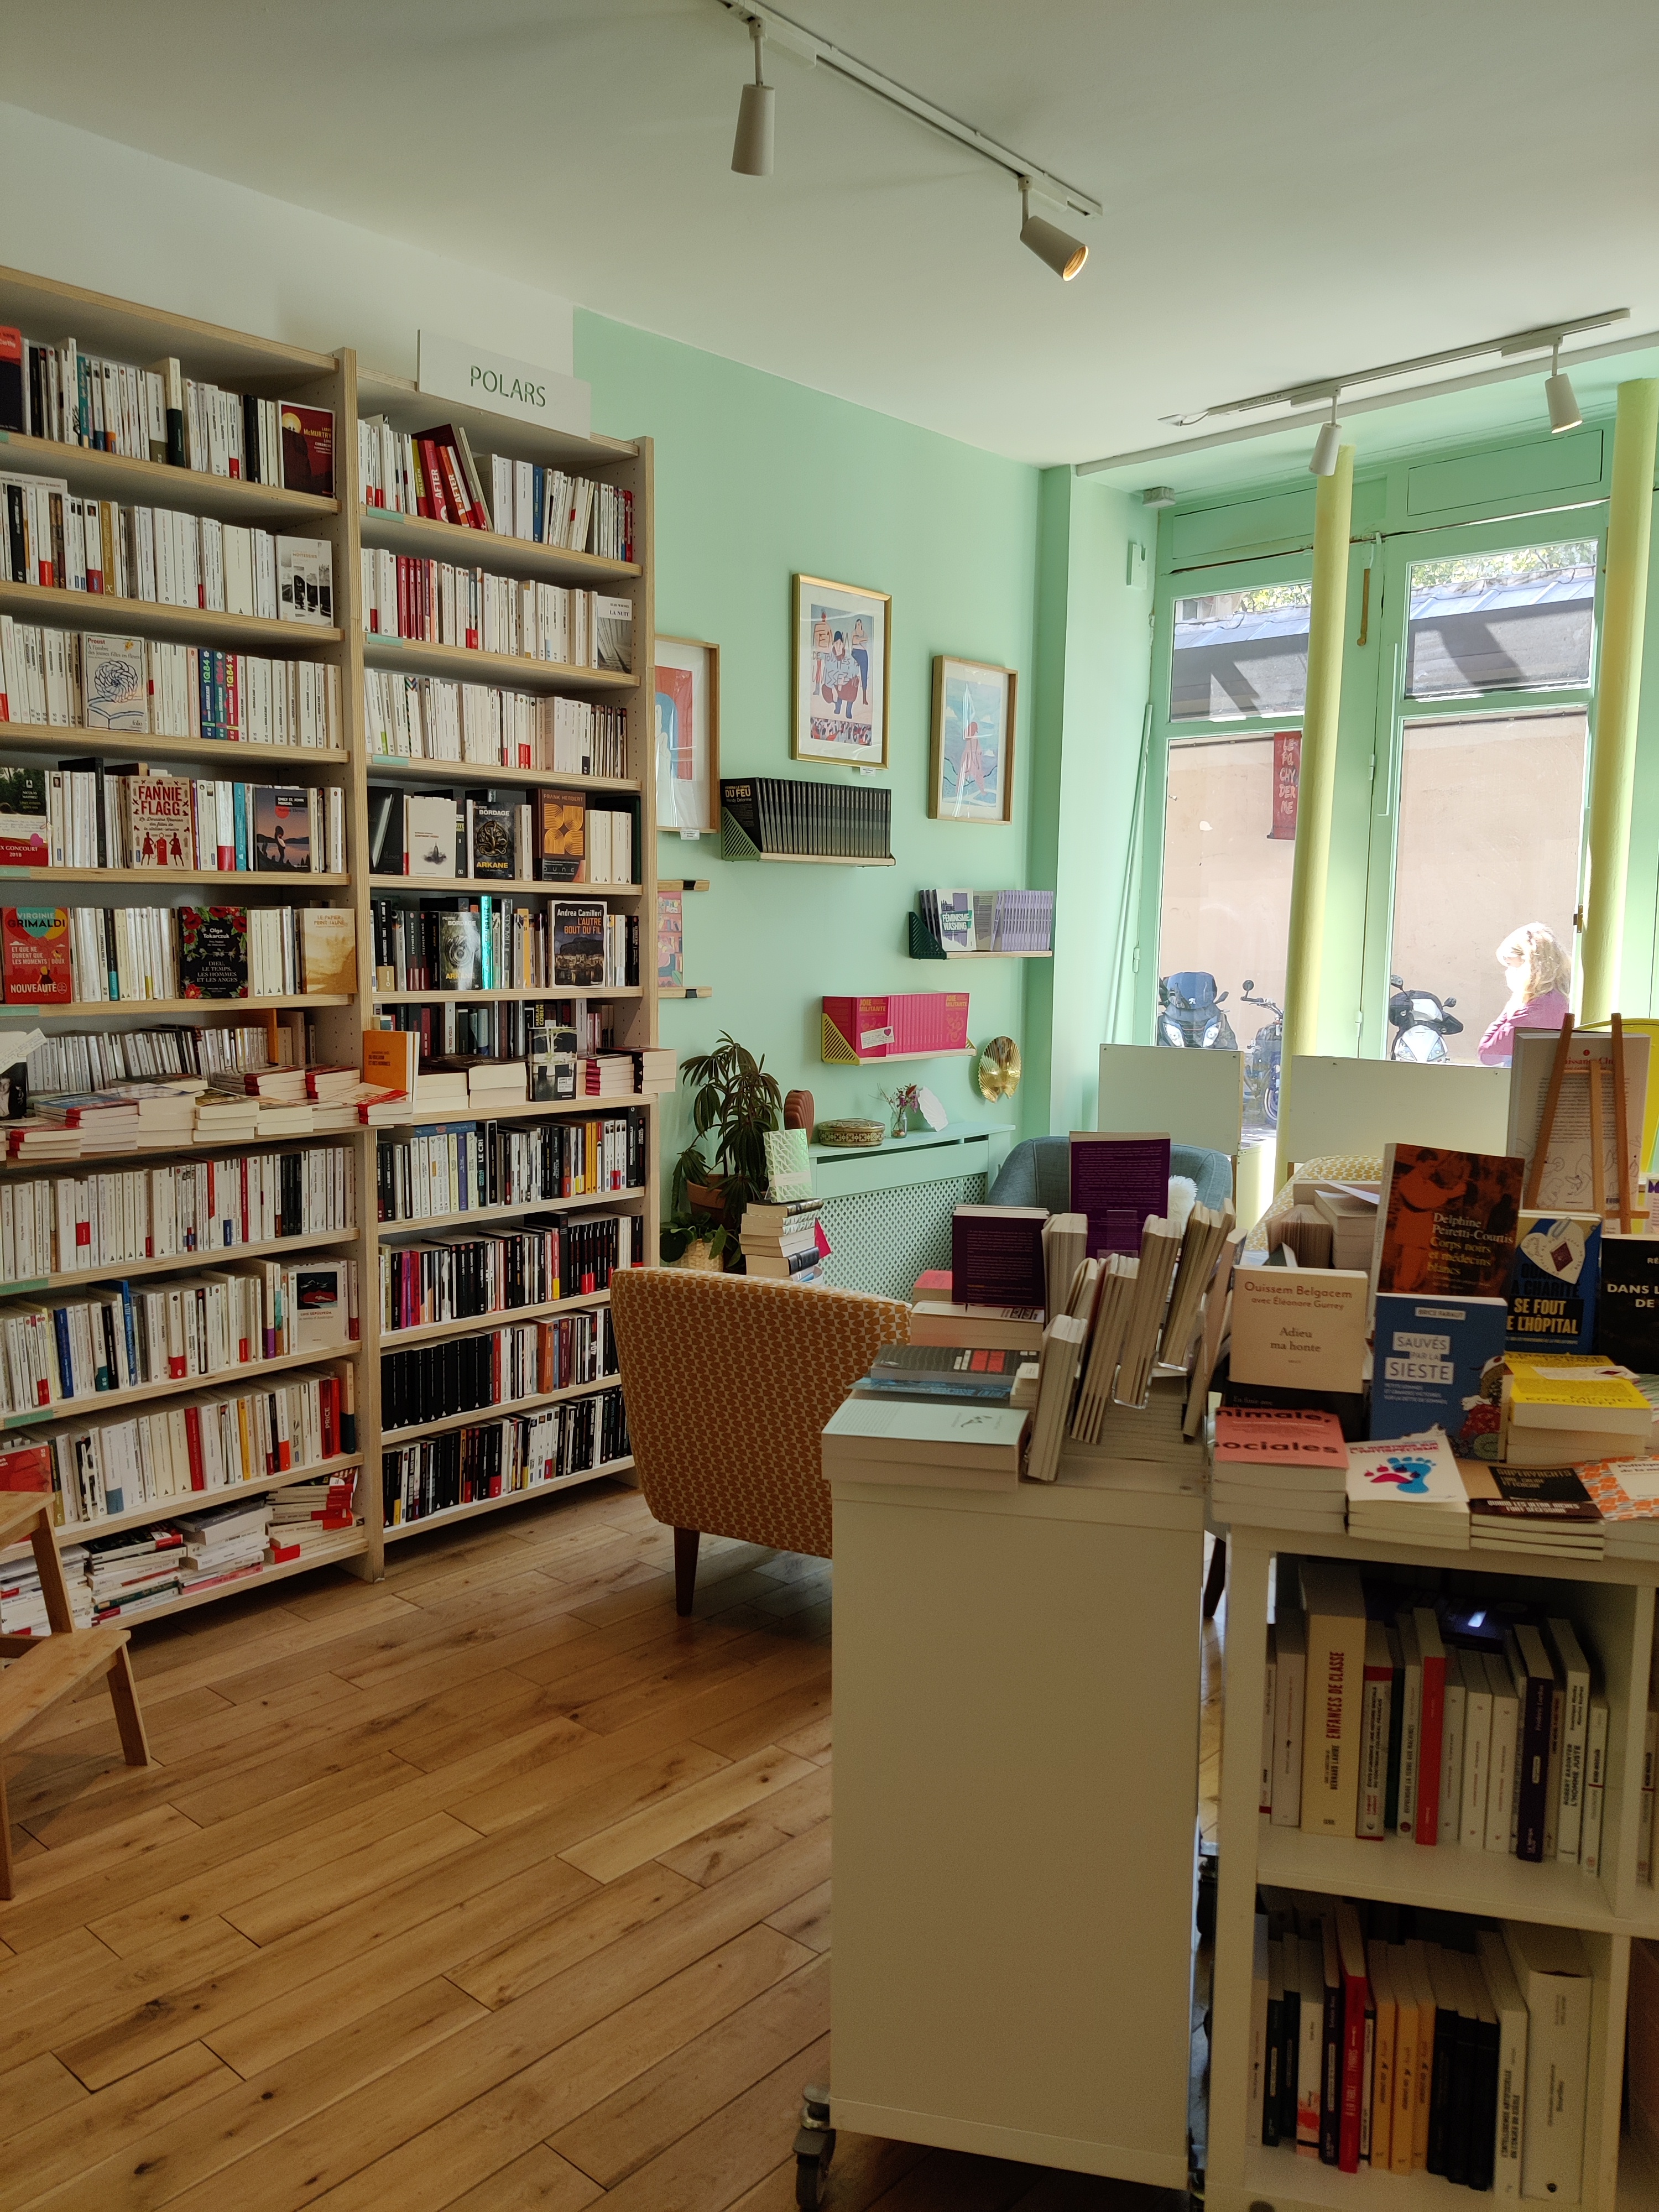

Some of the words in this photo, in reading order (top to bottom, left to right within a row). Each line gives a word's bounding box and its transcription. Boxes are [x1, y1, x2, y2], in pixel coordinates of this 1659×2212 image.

[471, 365, 546, 407] POLARS
[304, 429, 331, 439] McMURTRY
[431, 469, 442, 498] AFTER
[448, 473, 462, 503] AFTER
[202, 659, 211, 684] 1Q84
[226, 664, 234, 688] 1Q84
[1283, 736, 1295, 752] LE
[1279, 767, 1296, 784] CHY
[138, 786, 182, 801] FANNIE
[726, 789, 734, 797] DU
[736, 788, 751, 797] FEU
[1279, 784, 1296, 799] DER
[141, 801, 180, 816] FLAGG
[1281, 800, 1294, 815] ME
[8, 919, 65, 928] GRIMALDI
[578, 917, 602, 926] L'AUTRE
[942, 912, 970, 922] FÉMINISME
[564, 926, 580, 934] BOUT
[582, 926, 591, 934] DU
[592, 926, 602, 935] FIL
[943, 922, 967, 931] WASHING
[11, 983, 57, 993] NOUVEAUTÉ
[478, 1151, 484, 1163] LE
[1433, 1212, 1481, 1228] Delphine
[1432, 1224, 1514, 1244] Peiretti-Courtis
[1430, 1237, 1462, 1251] Corps
[1465, 1243, 1491, 1253] noirs
[1442, 1253, 1491, 1266] médecins
[1427, 1261, 1461, 1275] blancs
[1244, 1281, 1293, 1295] Ouissem
[1296, 1285, 1353, 1298] Belgacem
[1606, 1284, 1650, 1294] DANS
[1273, 1296, 1311, 1307] Éléonore
[1514, 1297, 1530, 1313] SE
[1533, 1298, 1567, 1316] FOUT
[1635, 1298, 1655, 1308] DE
[1517, 1314, 1578, 1334] L'HÔPITAL
[1279, 1327, 1313, 1338] Adieu
[1270, 1342, 1287, 1350] ma
[1290, 1340, 1322, 1352] honte
[1397, 1336, 1447, 1350] SAUVÉS
[1390, 1361, 1449, 1380] SIESTE
[1328, 1652, 1344, 1682] CLASSE
[1328, 1684, 1343, 1694] DE
[1326, 1697, 1342, 1739] ENFANCES
[1331, 1745, 1339, 1764] LAHIRE
[1564, 1744, 1573, 1777] BADINTER
[1572, 1745, 1581, 1770] JUSTE
[1329, 1765, 1338, 1790] BERNARD
[1563, 1780, 1572, 1806] ROBERT
[1571, 1772, 1579, 1806] L'HOMME
